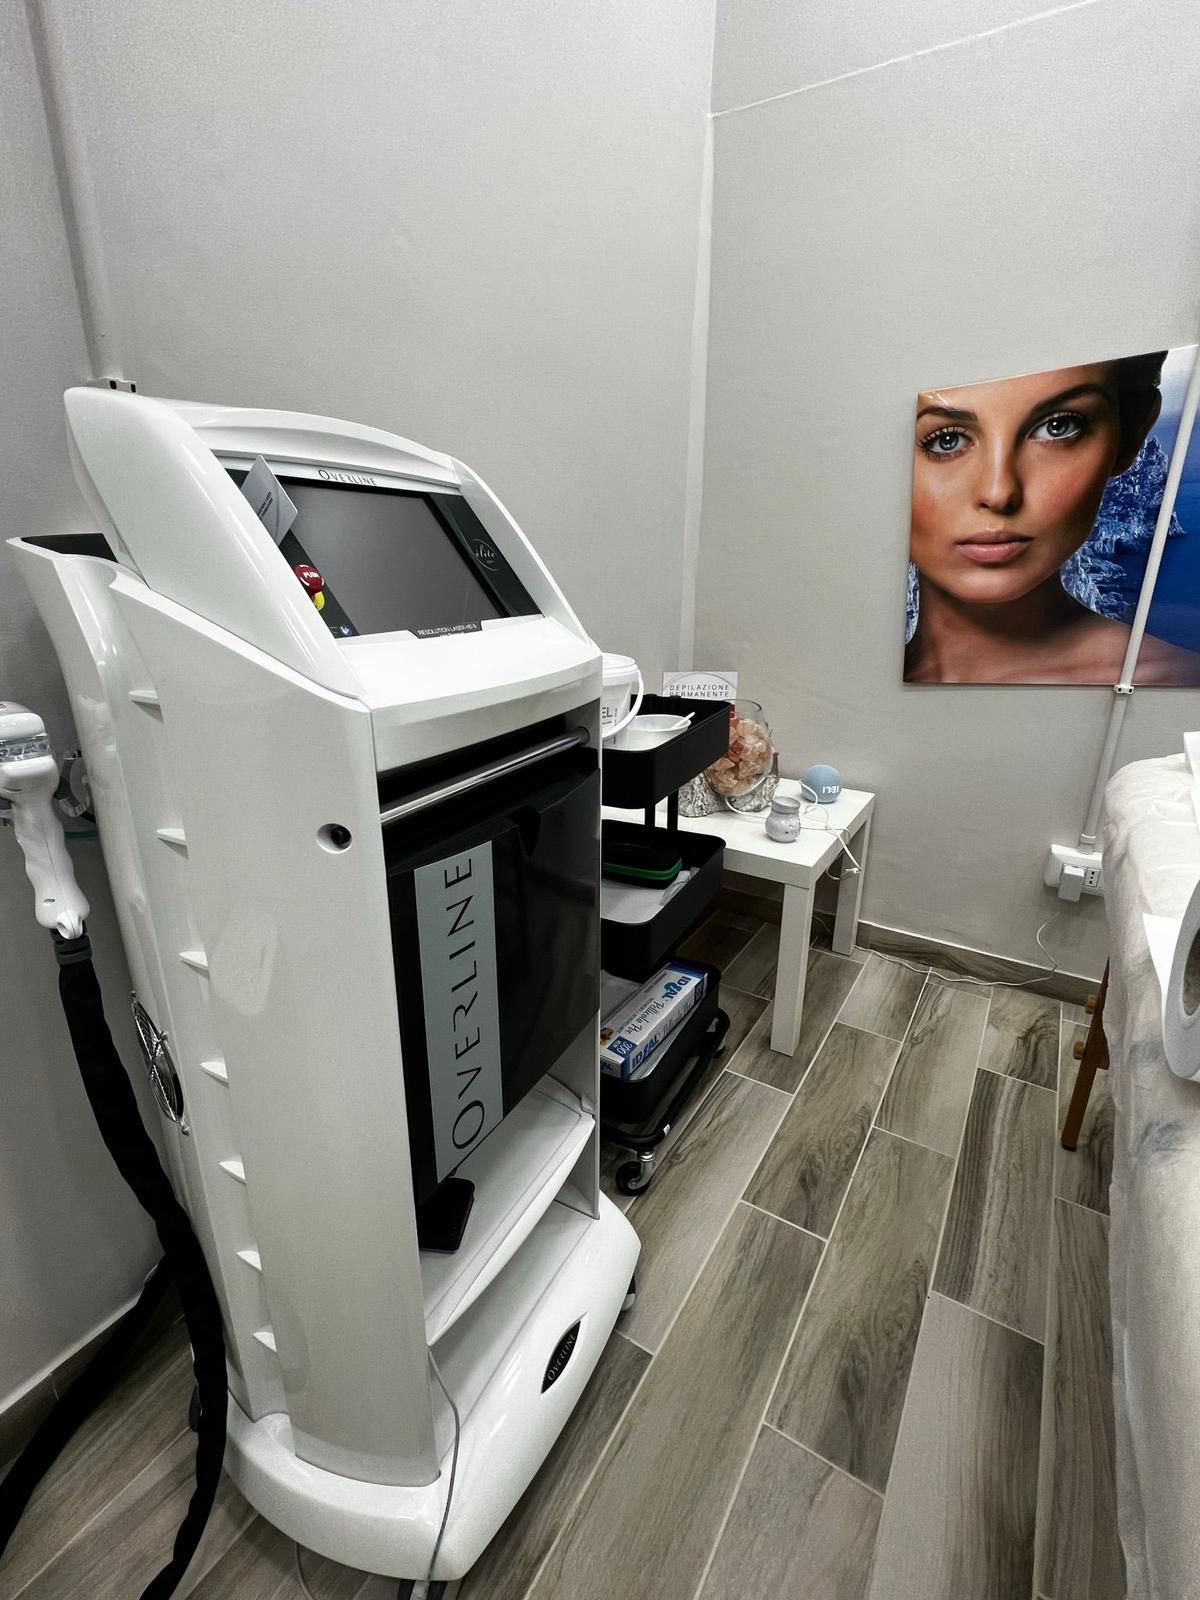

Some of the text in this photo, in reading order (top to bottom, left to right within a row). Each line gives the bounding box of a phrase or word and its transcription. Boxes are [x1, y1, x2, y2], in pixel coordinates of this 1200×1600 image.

[318, 469, 377, 486] OVERLINE
[302, 571, 320, 579] PUSH
[661, 975, 692, 999] IDEAL
[444, 858, 485, 1150] OVERLINE
[616, 1040, 633, 1055] 300
[547, 1333, 576, 1381] OVERLINE
